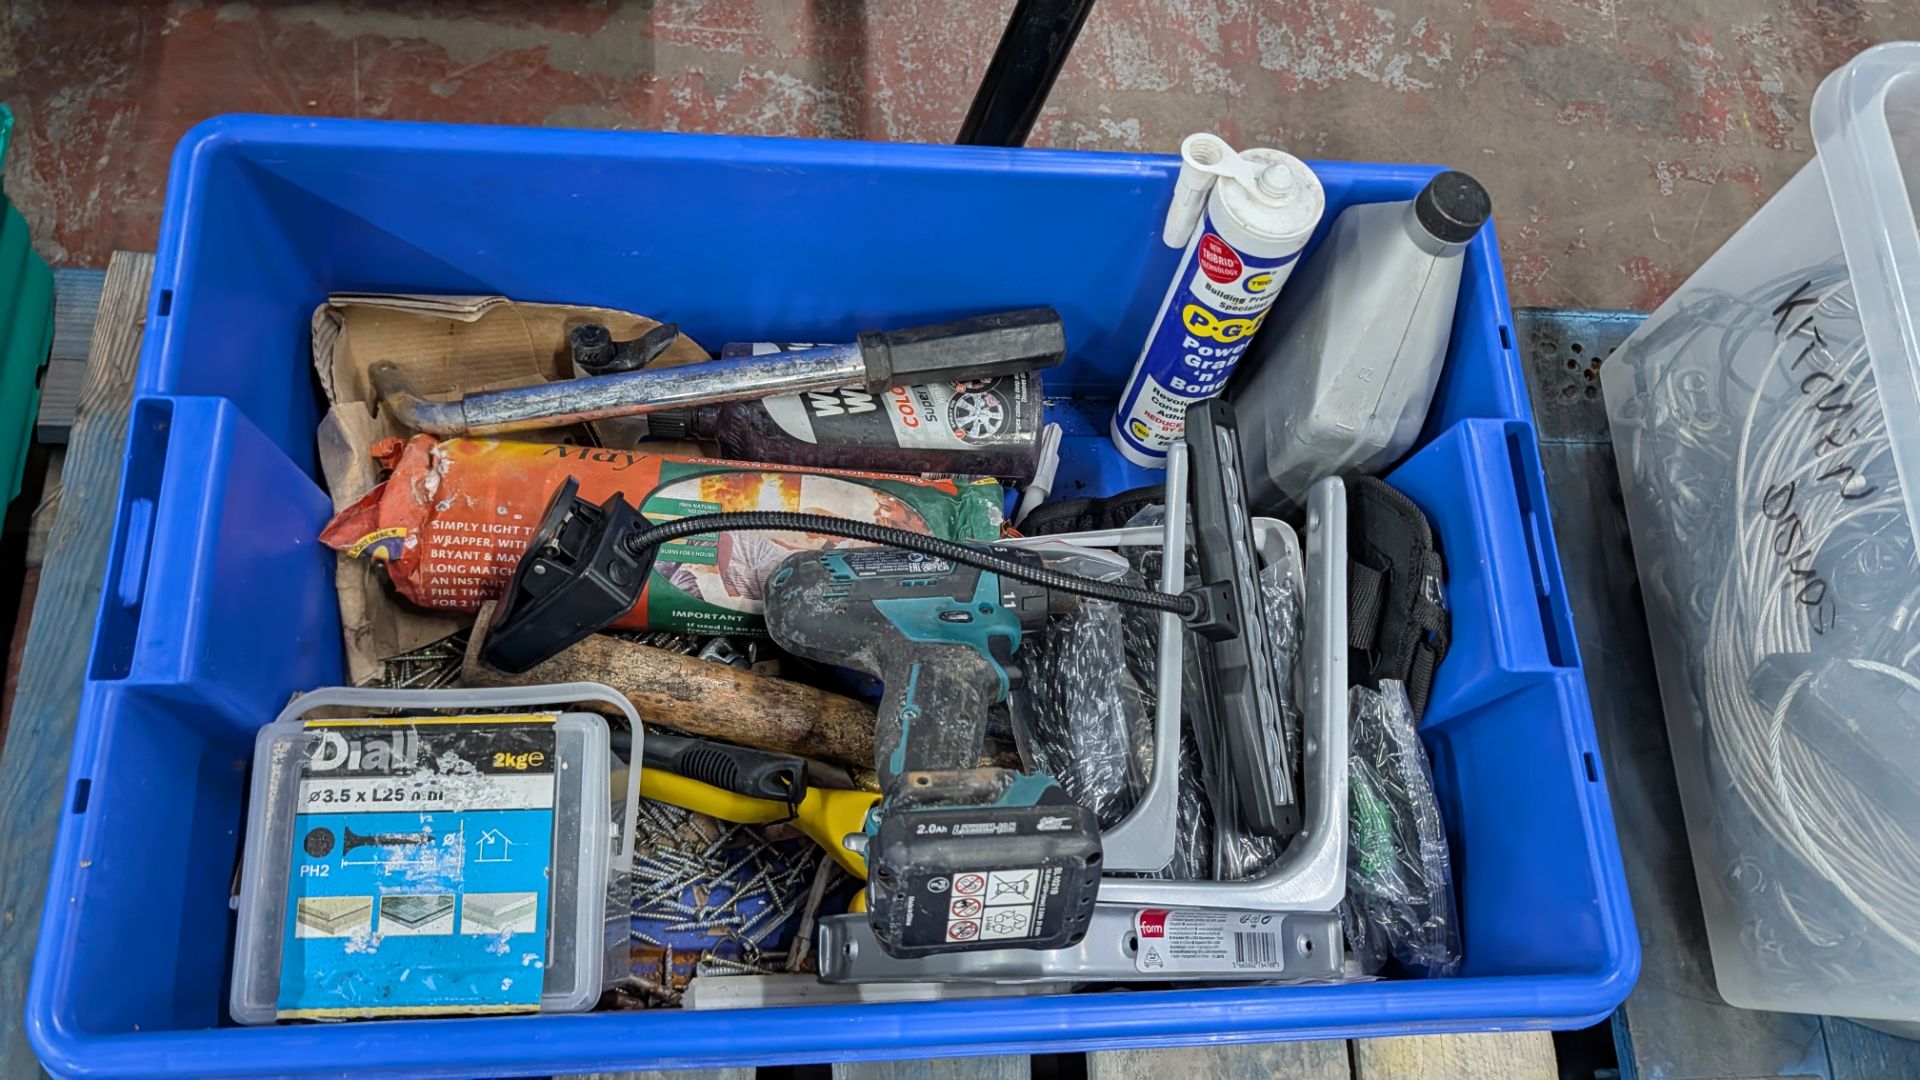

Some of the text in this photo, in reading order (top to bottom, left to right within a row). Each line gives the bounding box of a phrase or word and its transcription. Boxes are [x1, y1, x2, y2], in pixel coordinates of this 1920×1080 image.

[1202, 247, 1234, 268] TRIBRID
[1200, 258, 1239, 276] TECHNOLOGY
[1205, 282, 1247, 305] Building
[1184, 354, 1240, 371] Grab
[916, 390, 938, 423] Super
[1151, 396, 1185, 414] Const
[431, 520, 479, 532] SIMPLY
[481, 523, 520, 535] LIGHT
[431, 549, 480, 561] BRYANT
[483, 552, 494, 561] &
[660, 548, 679, 556] BURNS
[430, 563, 467, 574] LONG
[431, 577, 508, 588] AN INSTANT
[431, 588, 496, 597] FIRE THAT
[432, 599, 458, 607] FOR
[460, 600, 469, 608] 2
[671, 610, 745, 622] IMPORTANT
[371, 787, 405, 802] L25
[916, 823, 948, 835] 2.0Ah
[299, 865, 331, 878] PH2
[1139, 920, 1163, 935] form
